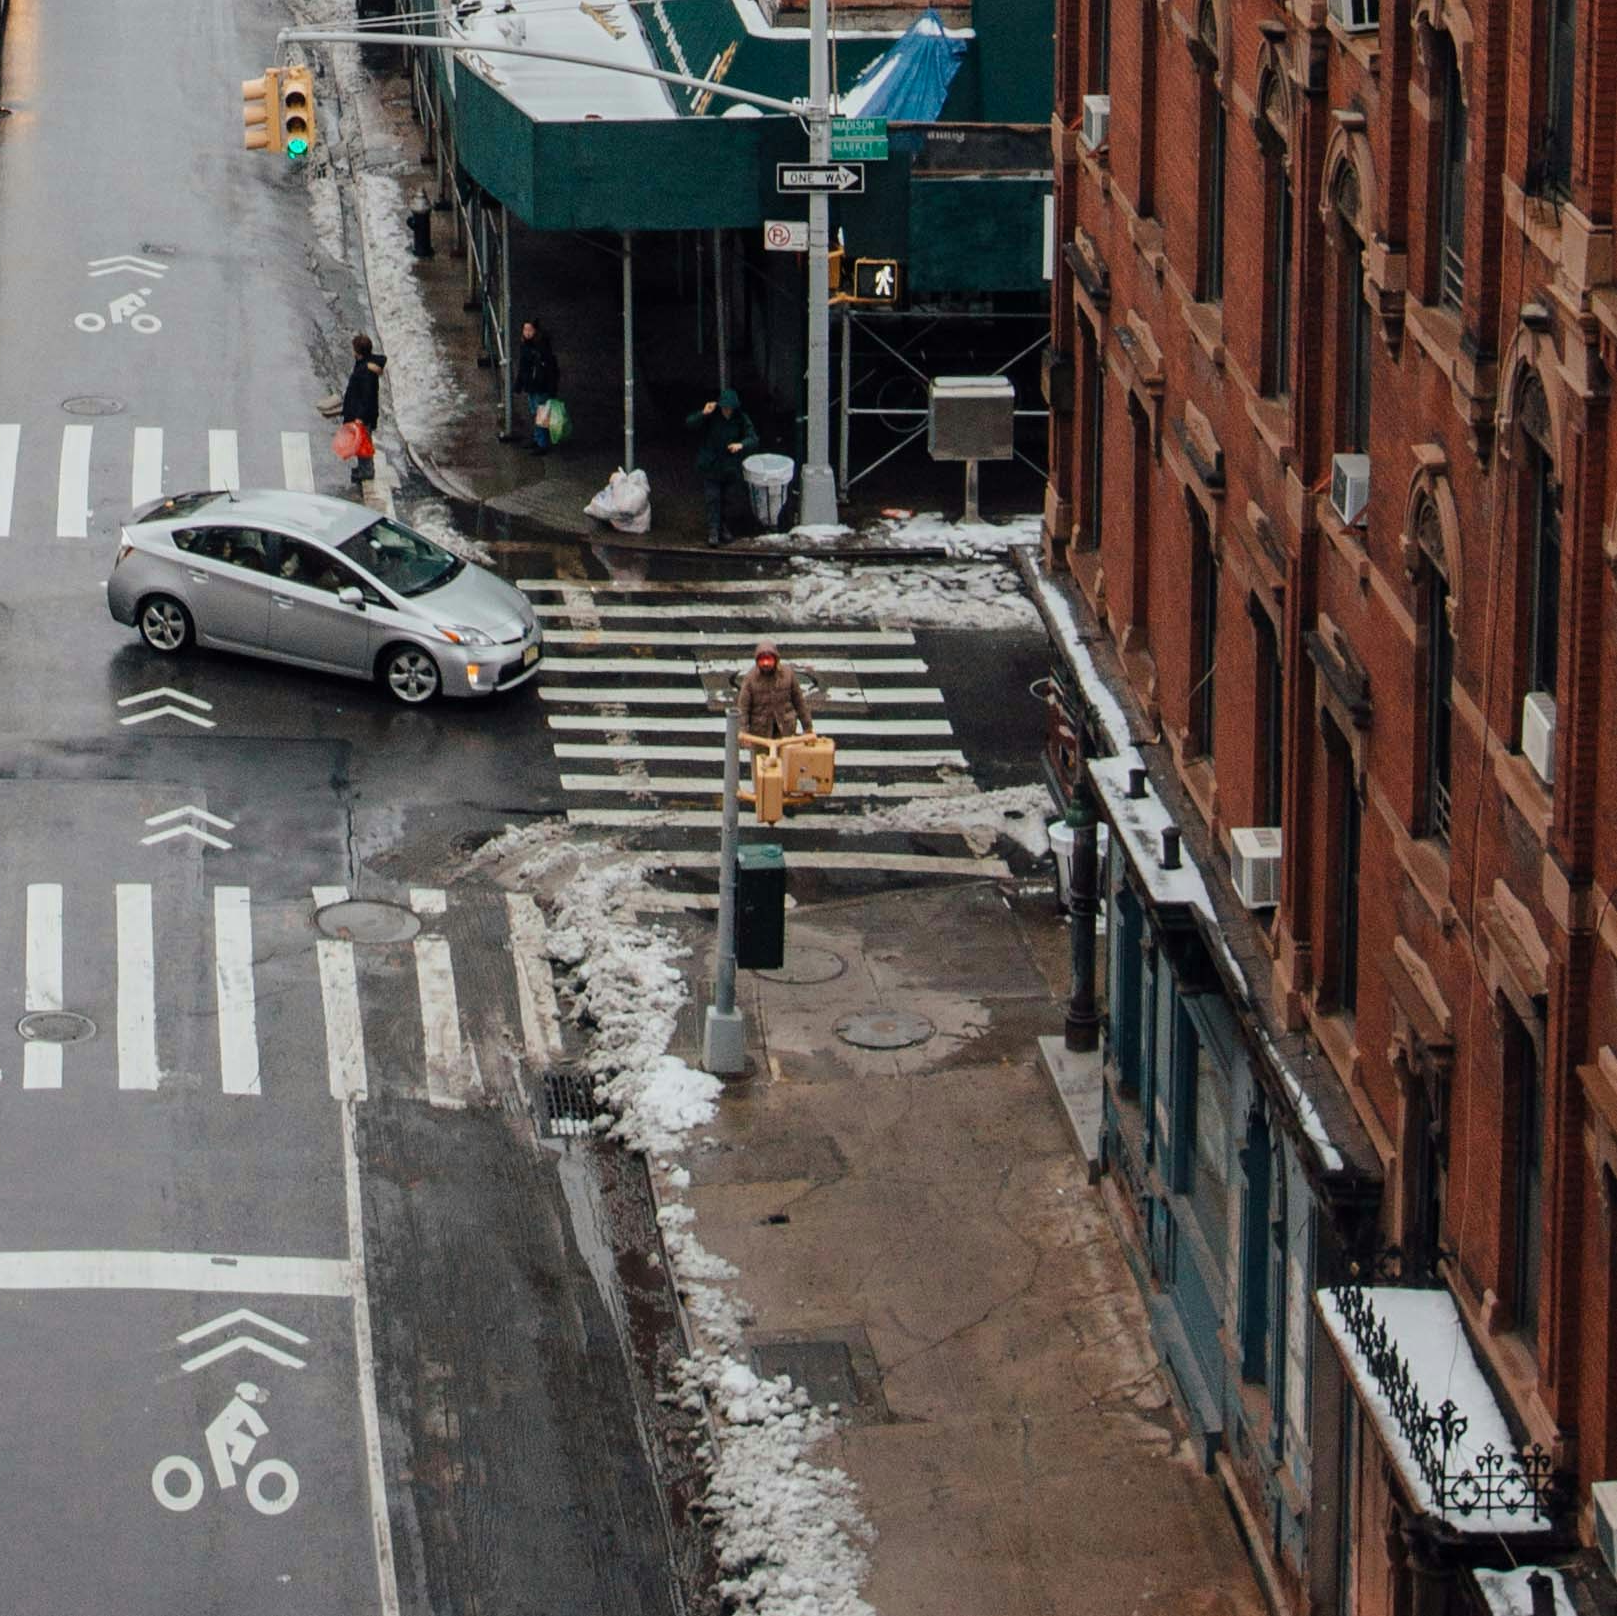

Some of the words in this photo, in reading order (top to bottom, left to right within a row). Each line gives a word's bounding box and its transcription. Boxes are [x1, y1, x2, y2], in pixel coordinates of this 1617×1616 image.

[833, 120, 875, 131] MADISON
[833, 142, 873, 152] MARKET
[790, 173, 815, 184] ONE
[825, 172, 851, 184] WAY
